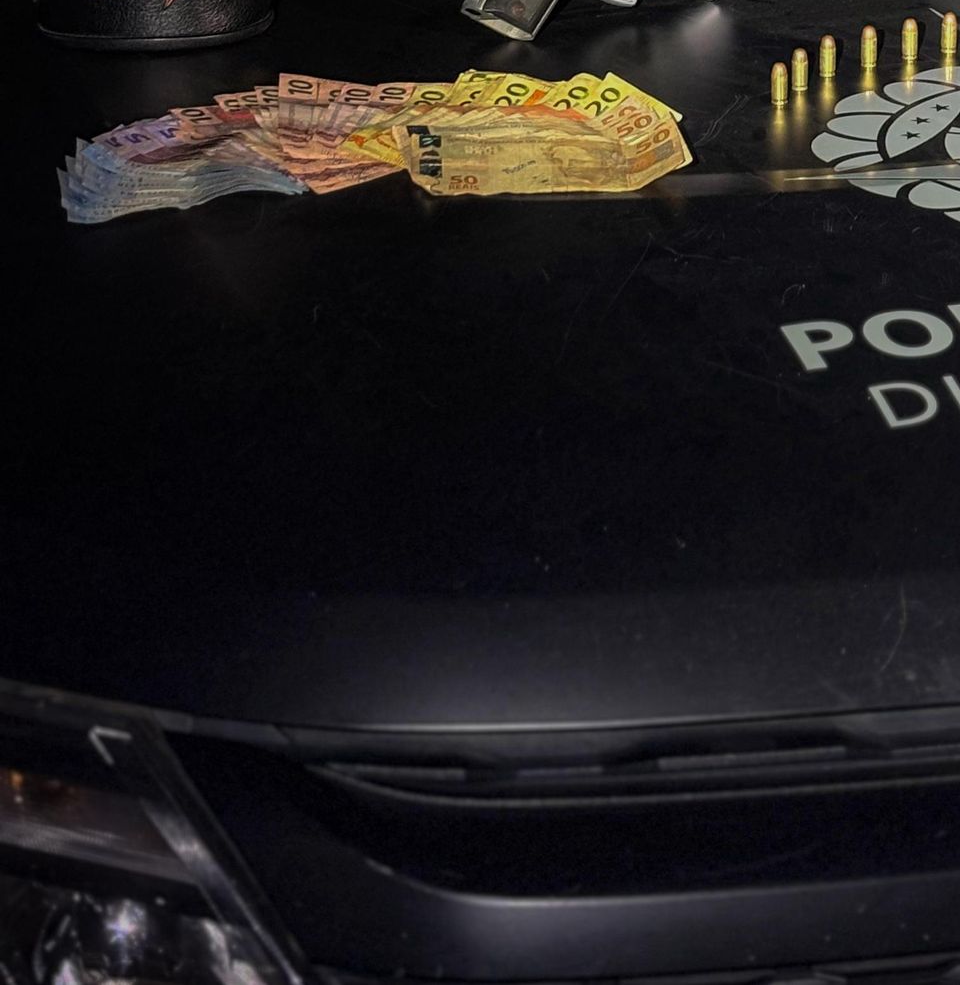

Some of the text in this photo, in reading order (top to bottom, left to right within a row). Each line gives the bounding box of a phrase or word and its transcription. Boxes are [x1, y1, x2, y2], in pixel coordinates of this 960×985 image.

[288, 79, 313, 95] 10
[379, 87, 407, 101] 10
[344, 88, 371, 102] 10
[616, 115, 653, 138] 50
[636, 129, 670, 154] 50
[450, 175, 478, 185] 50
